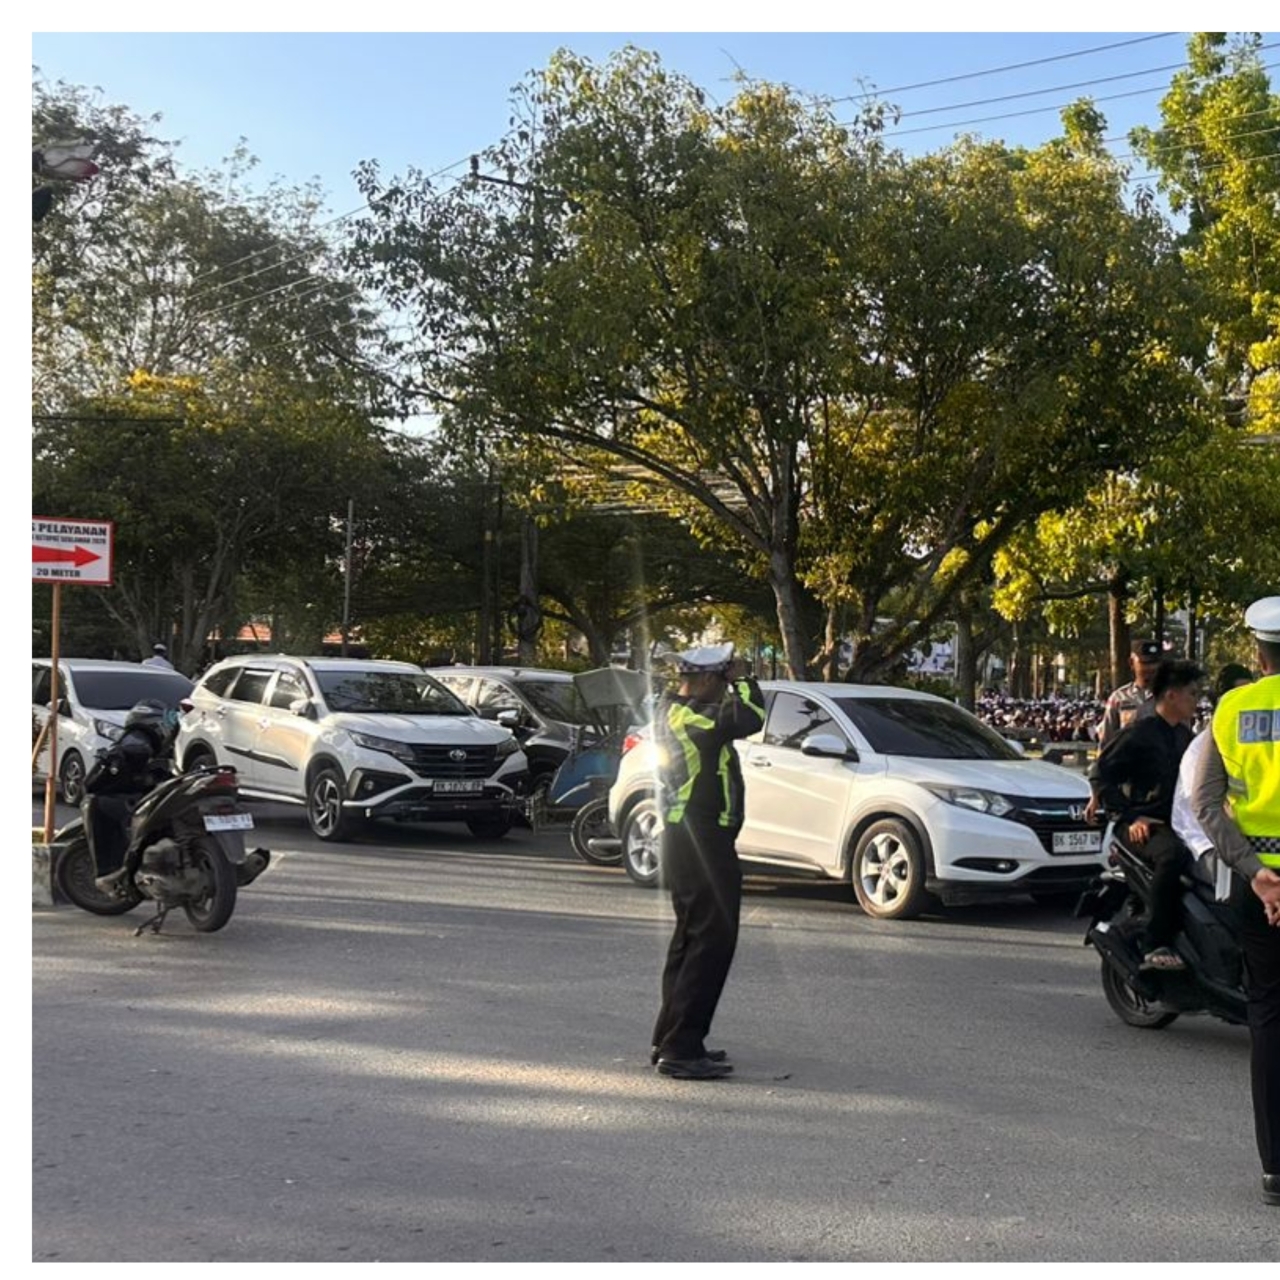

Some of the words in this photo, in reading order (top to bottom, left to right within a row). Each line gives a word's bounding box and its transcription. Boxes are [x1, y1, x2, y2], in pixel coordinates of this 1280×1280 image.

[38, 523, 107, 536] PELAYANAN
[36, 568, 49, 576] 20
[51, 569, 80, 577] METER
